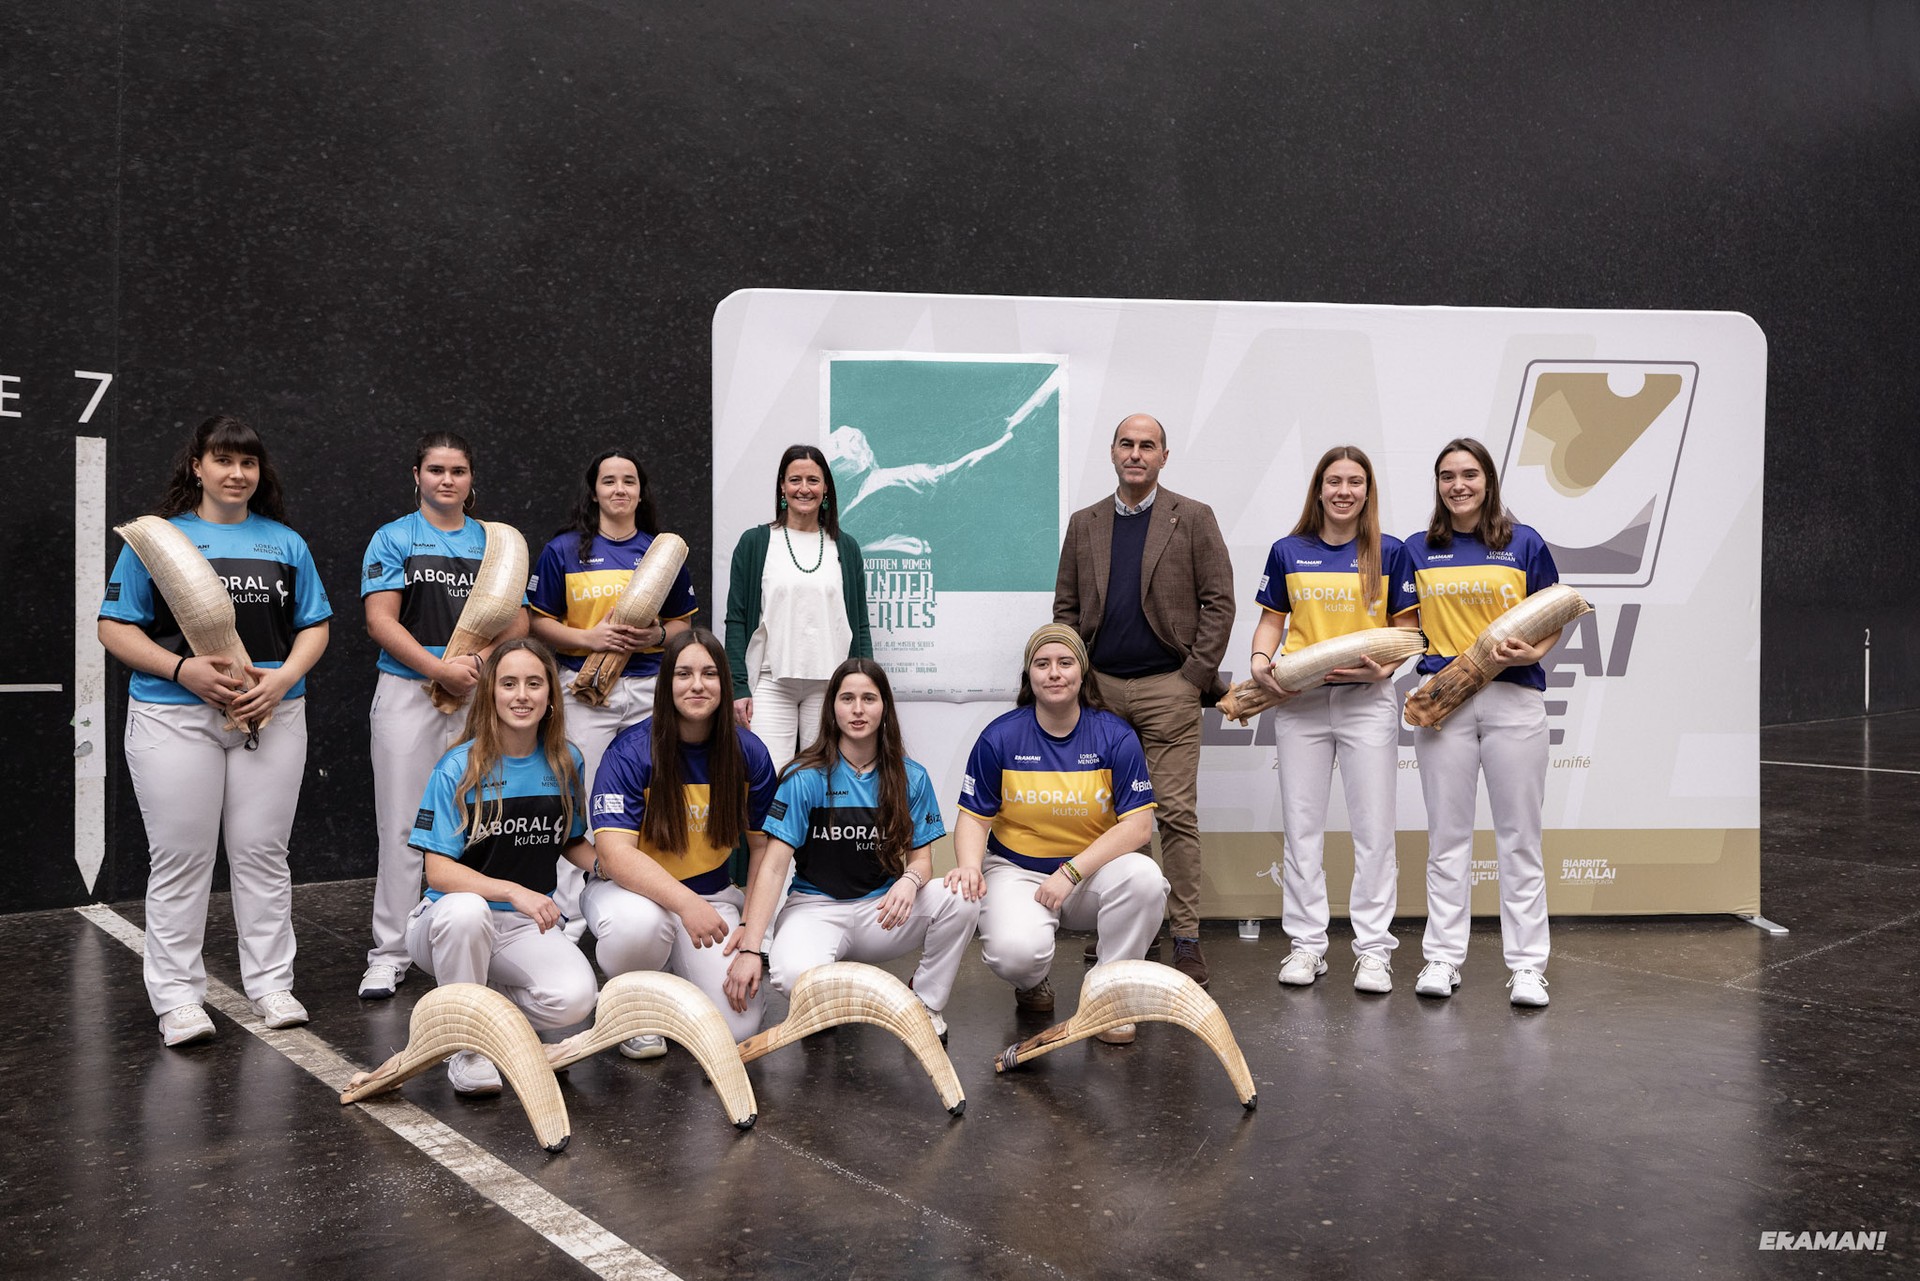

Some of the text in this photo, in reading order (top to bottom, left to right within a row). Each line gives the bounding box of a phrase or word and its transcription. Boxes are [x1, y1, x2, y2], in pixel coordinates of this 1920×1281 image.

[74, 370, 113, 424] 7
[863, 558, 931, 570] KOTREN WOMEN
[447, 587, 472, 598] kutx
[571, 583, 625, 602] LABOR
[864, 571, 937, 604] INTER
[1420, 580, 1492, 599] LABORAL
[231, 592, 270, 604] kutxa
[1459, 596, 1493, 606] kutxa
[1324, 602, 1356, 612] kutxa
[866, 601, 936, 634] ERIES
[1539, 603, 1642, 677] AI
[1864, 628, 1871, 646] 2
[1553, 756, 1591, 769] unifié
[1004, 788, 1088, 805] LABORAL
[1052, 806, 1089, 817] kutxa
[467, 816, 552, 840] ABORAL
[813, 825, 888, 841] LABORAL
[514, 833, 551, 847] kutxa
[855, 841, 882, 851] kutx
[1562, 858, 1608, 868] BIARRITZ
[1560, 868, 1617, 880] JAI ALAI
